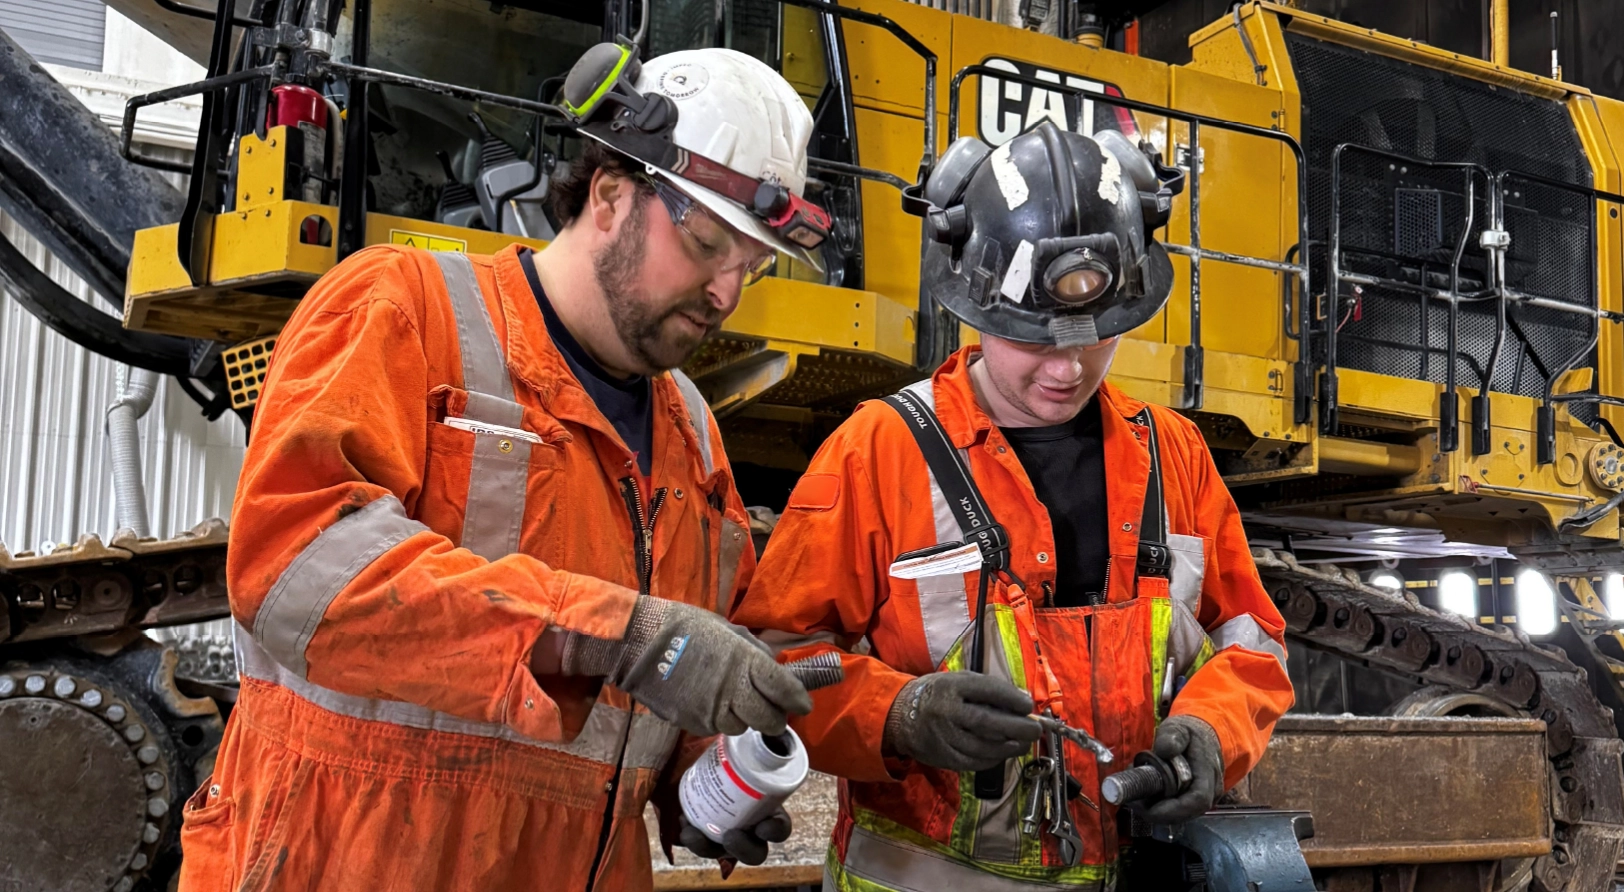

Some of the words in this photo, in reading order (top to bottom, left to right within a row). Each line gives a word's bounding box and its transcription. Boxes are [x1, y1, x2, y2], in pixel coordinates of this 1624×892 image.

[663, 87, 699, 98] TOMORROW
[981, 58, 1105, 147] CAT
[903, 401, 928, 429] TOUGH
[959, 496, 981, 528] DUCK
